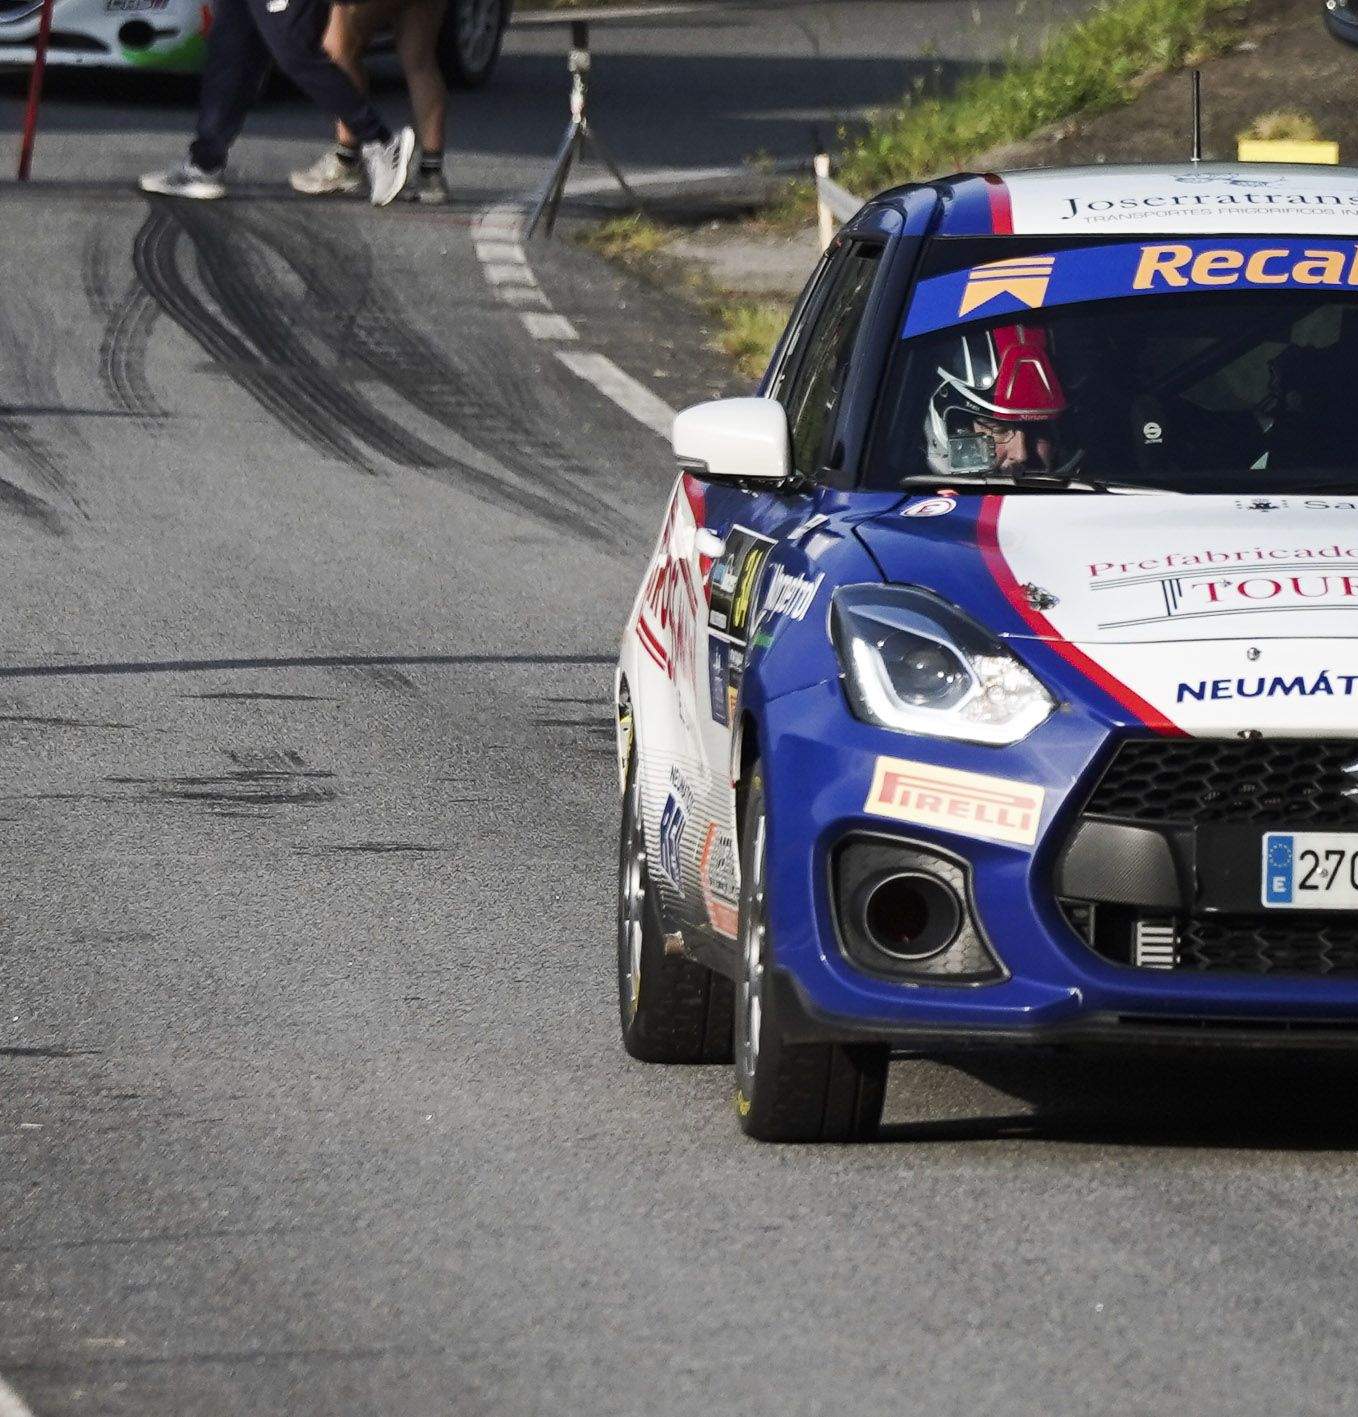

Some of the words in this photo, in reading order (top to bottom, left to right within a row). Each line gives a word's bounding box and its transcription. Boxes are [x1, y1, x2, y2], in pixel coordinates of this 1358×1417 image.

[1084, 207, 1213, 225] TRANSPORTES
[878, 771, 1036, 831] PIRELLI
[1272, 876, 1287, 893] E
